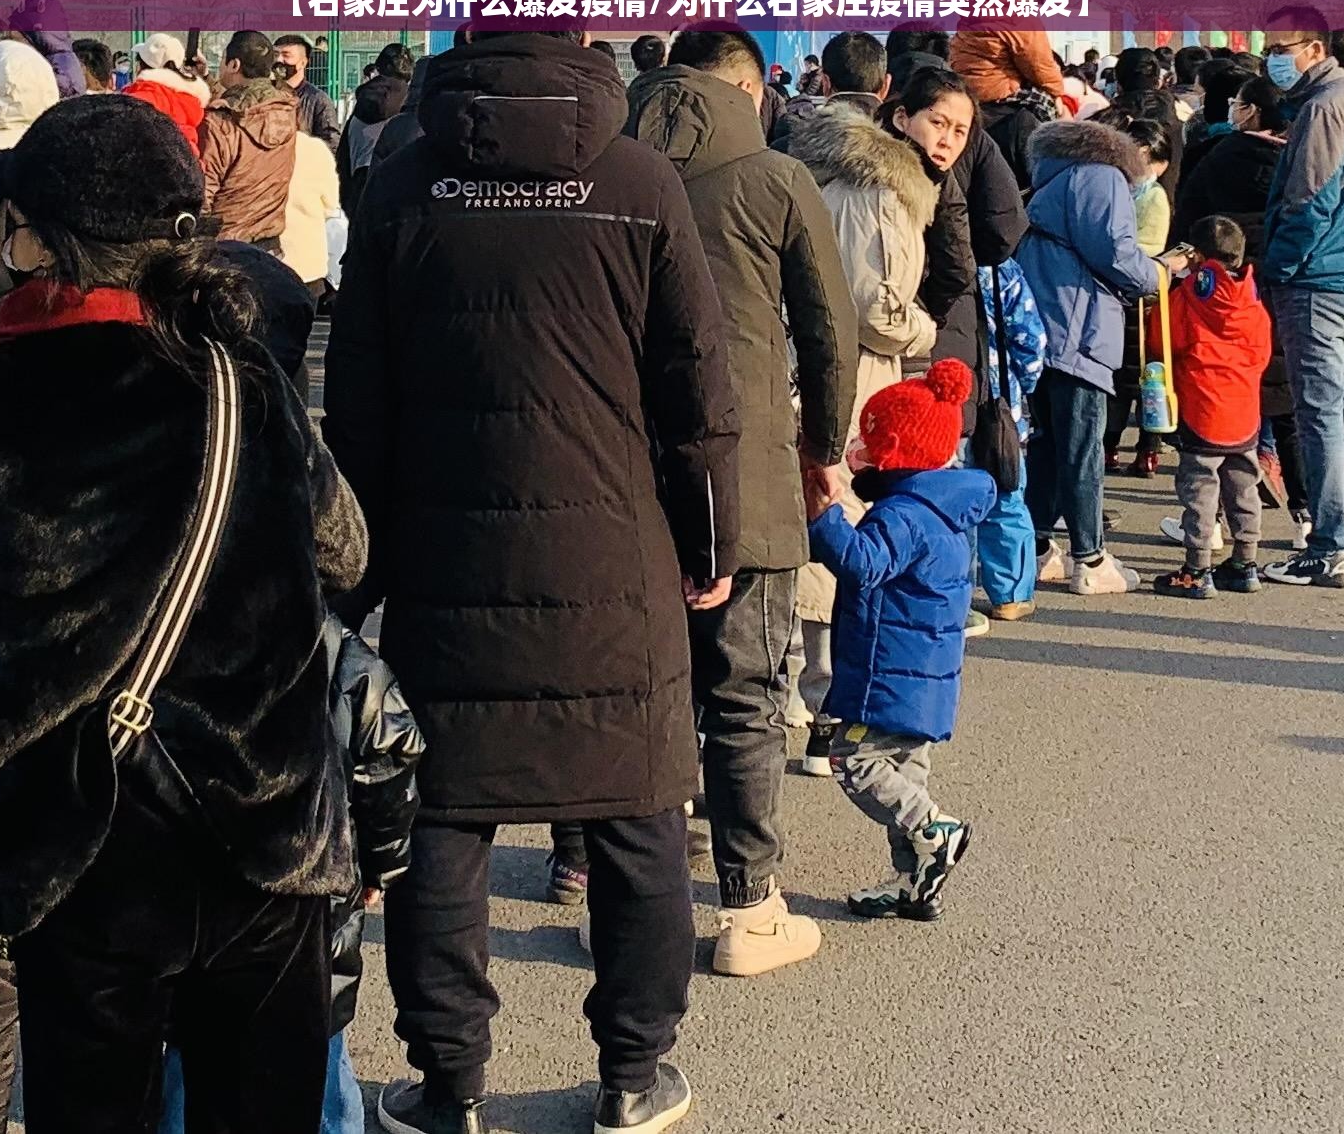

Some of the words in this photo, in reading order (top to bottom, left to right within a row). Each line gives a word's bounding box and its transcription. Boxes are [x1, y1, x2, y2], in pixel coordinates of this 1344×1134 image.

[442, 177, 594, 205] Democracy
[465, 198, 500, 208] FREE
[503, 198, 531, 208] AND
[535, 198, 571, 208] OPEN
